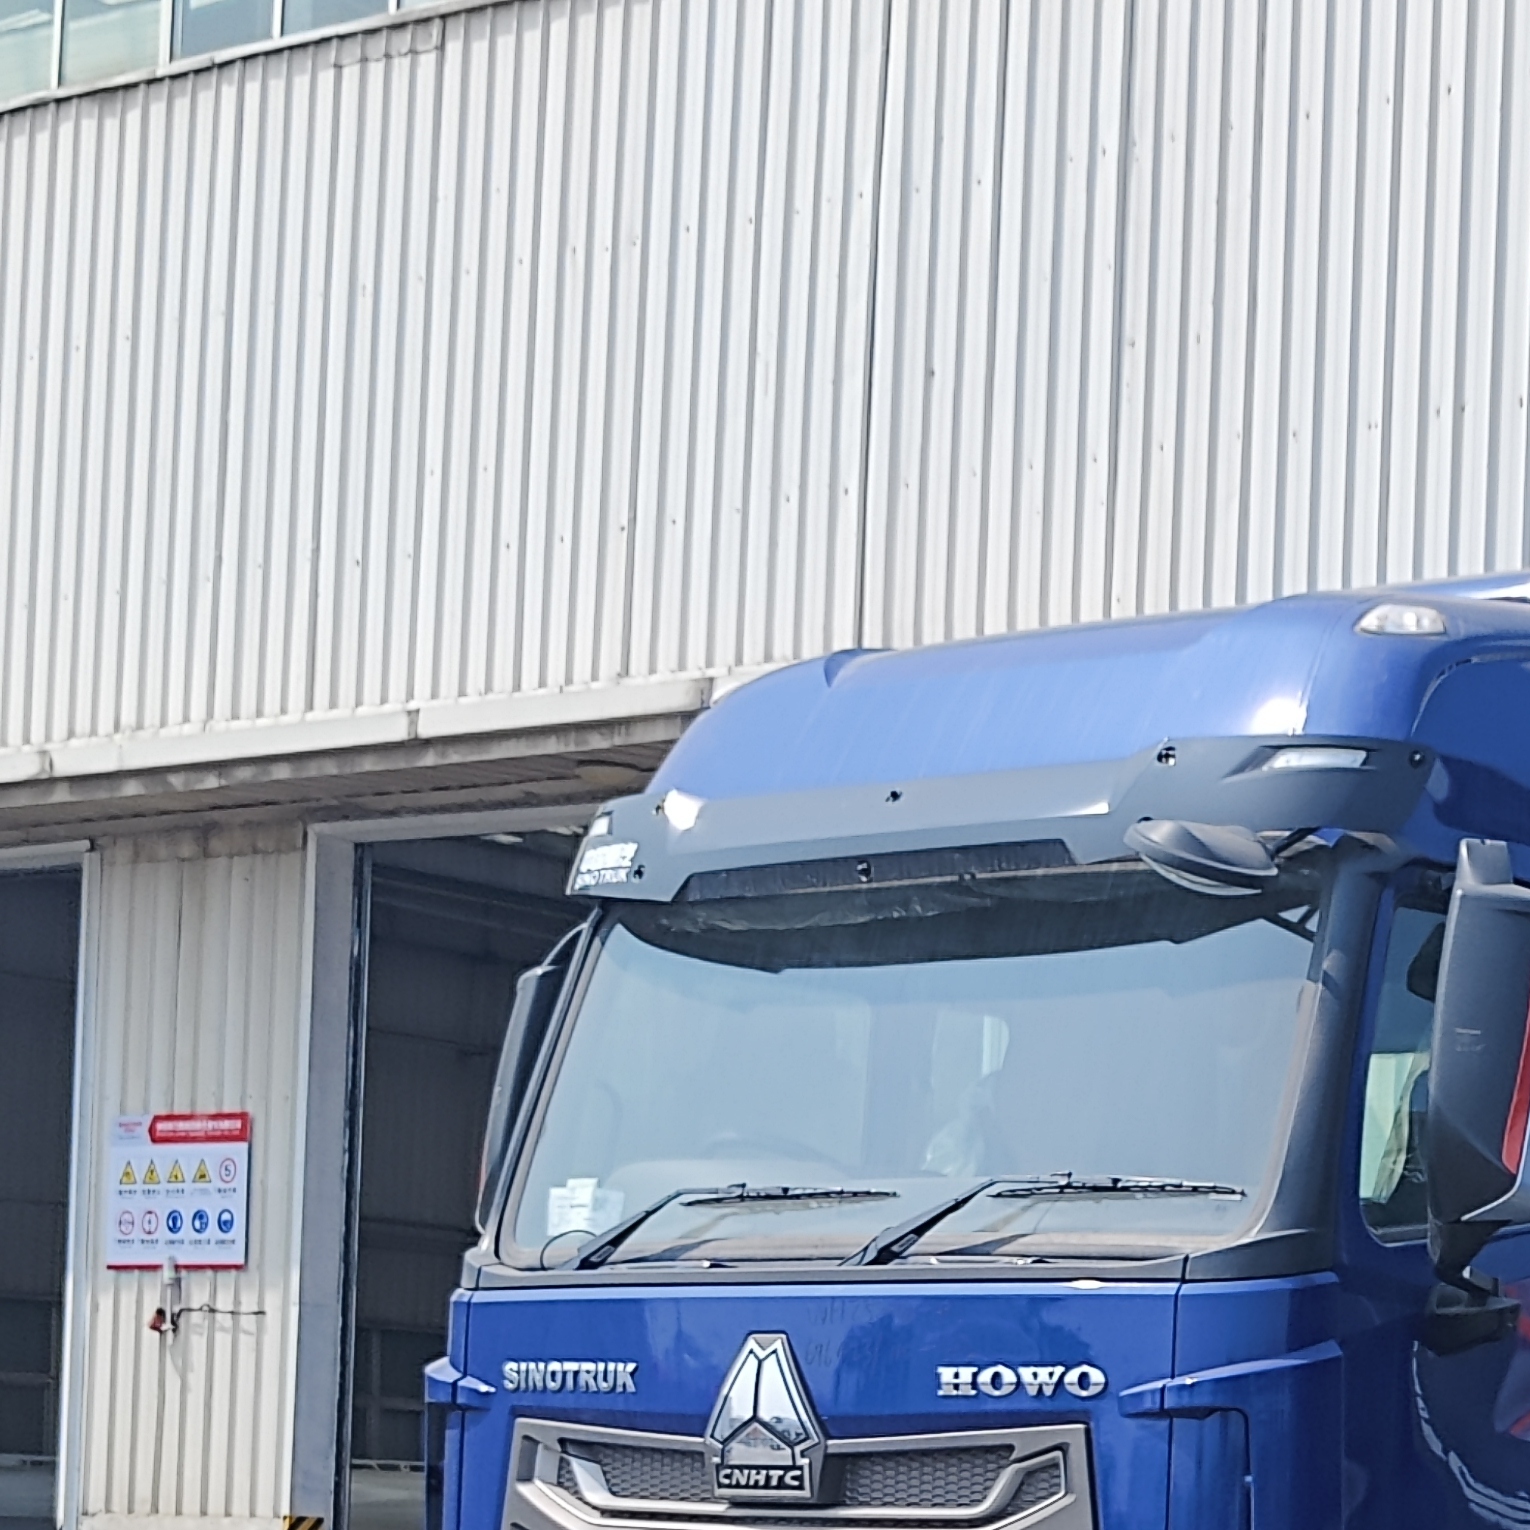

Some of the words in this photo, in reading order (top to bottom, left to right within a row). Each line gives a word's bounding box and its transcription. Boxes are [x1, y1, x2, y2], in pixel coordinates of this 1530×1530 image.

[502, 1359, 637, 1394] SINOTRUK
[936, 1363, 1106, 1397] HOWO
[718, 1468, 803, 1487] CNHTC
